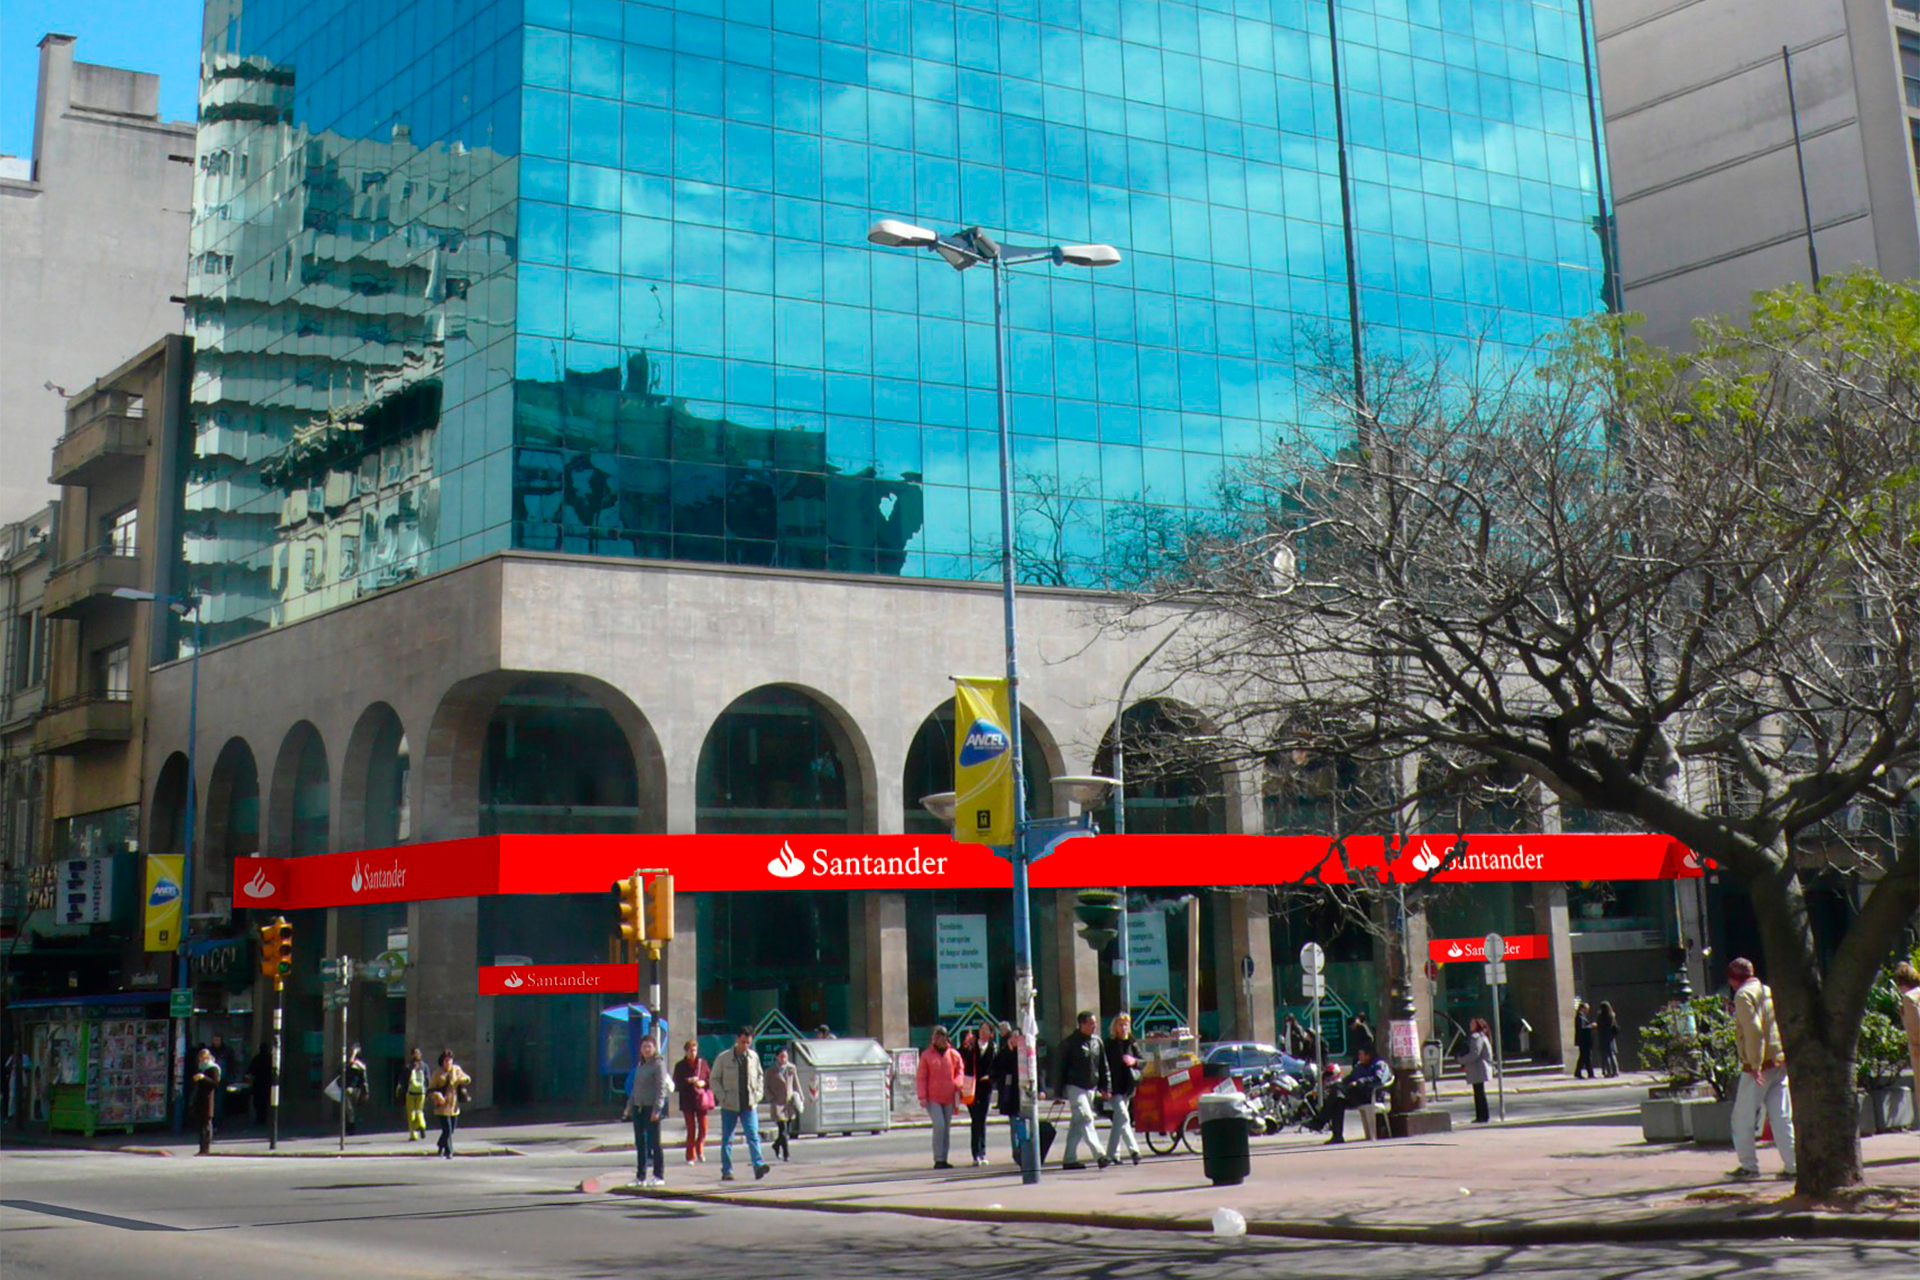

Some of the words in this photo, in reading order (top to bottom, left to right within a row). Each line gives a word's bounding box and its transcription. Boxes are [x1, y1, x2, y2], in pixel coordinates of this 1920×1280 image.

[965, 733, 1005, 746] ANCEL
[812, 846, 948, 877] Santander
[364, 859, 406, 890] Santander
[1464, 942, 1521, 957] Sander
[526, 970, 601, 988] Santander
